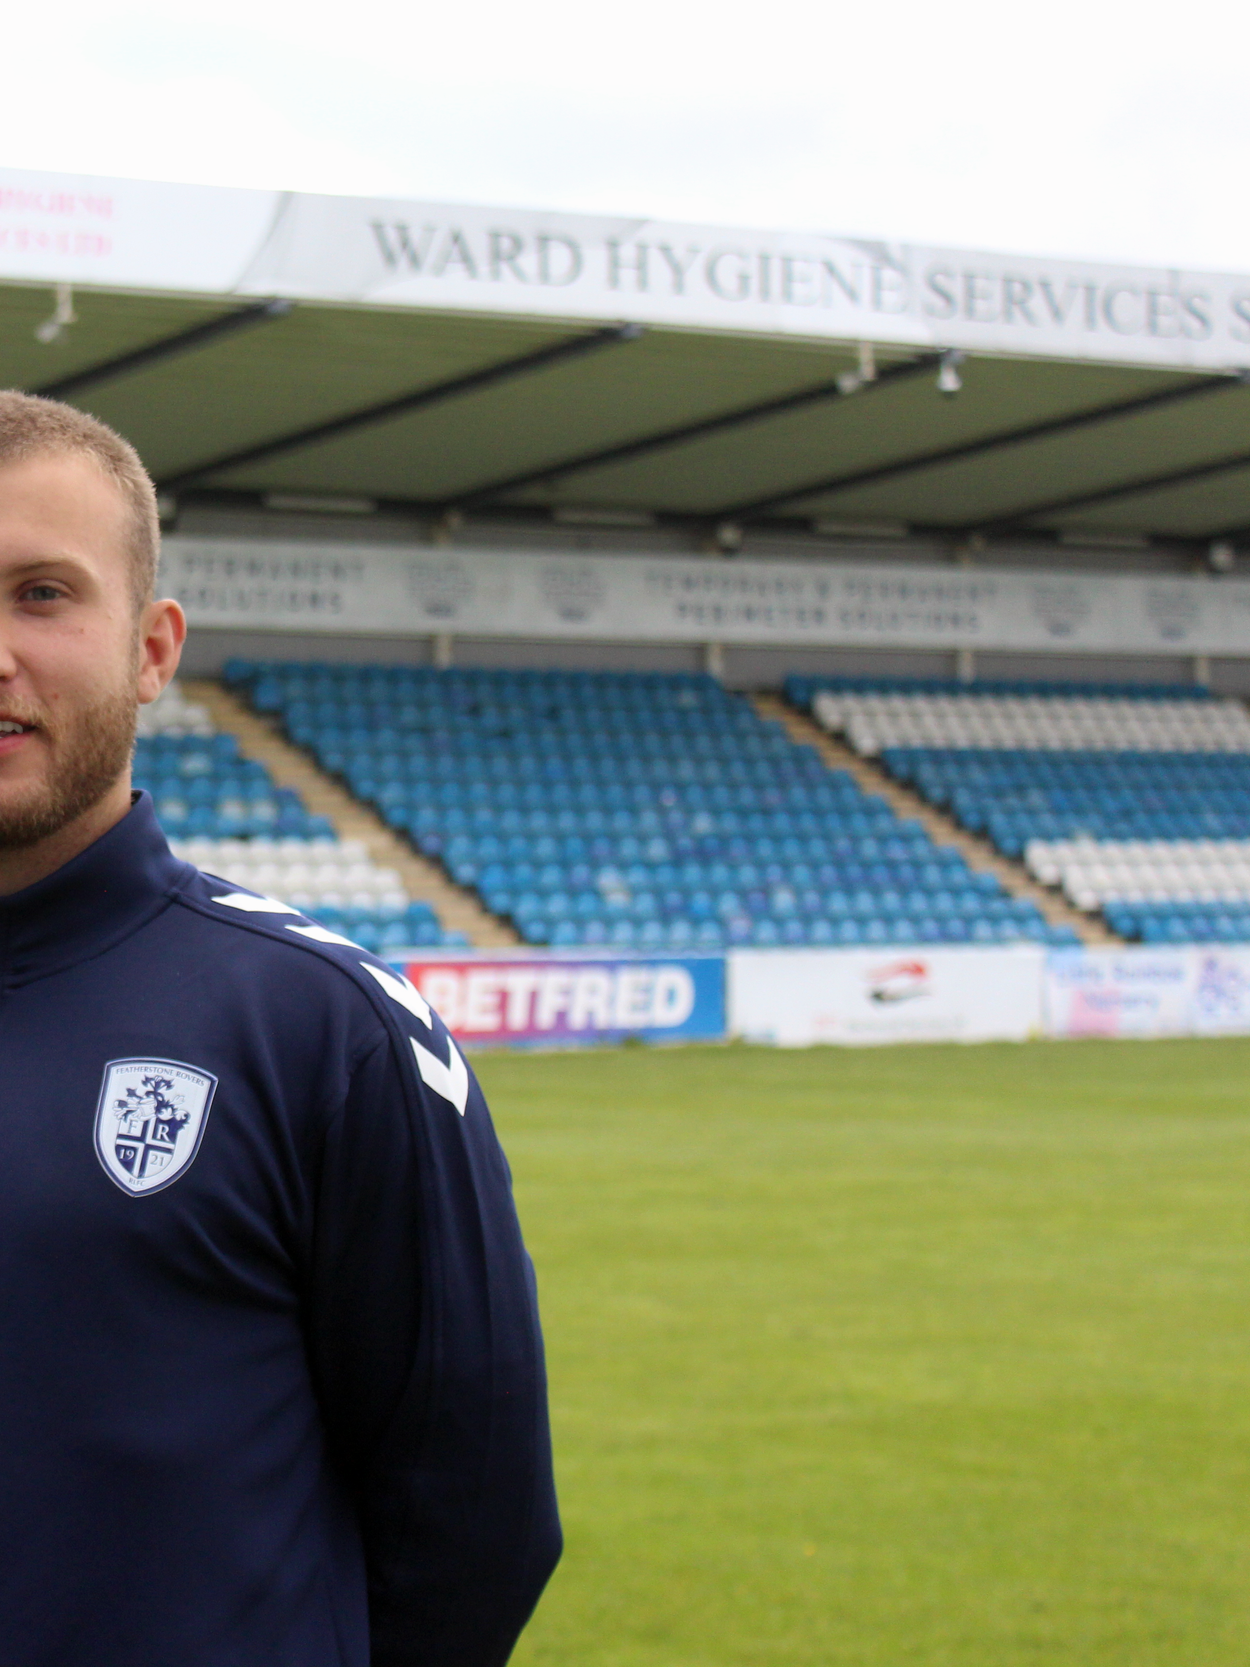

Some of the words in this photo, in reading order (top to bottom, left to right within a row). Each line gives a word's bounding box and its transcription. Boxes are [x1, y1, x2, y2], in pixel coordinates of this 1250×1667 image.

[369, 221, 583, 288] WARD
[605, 238, 908, 316] HYGIENE
[921, 263, 1214, 342] SERVICES
[419, 964, 695, 1032] BETFRED
[116, 1066, 173, 1077] FEATHERSTONE
[175, 1071, 205, 1087] ROVERS
[156, 1123, 170, 1142] R
[119, 1147, 135, 1160] 19
[150, 1154, 165, 1167] 21
